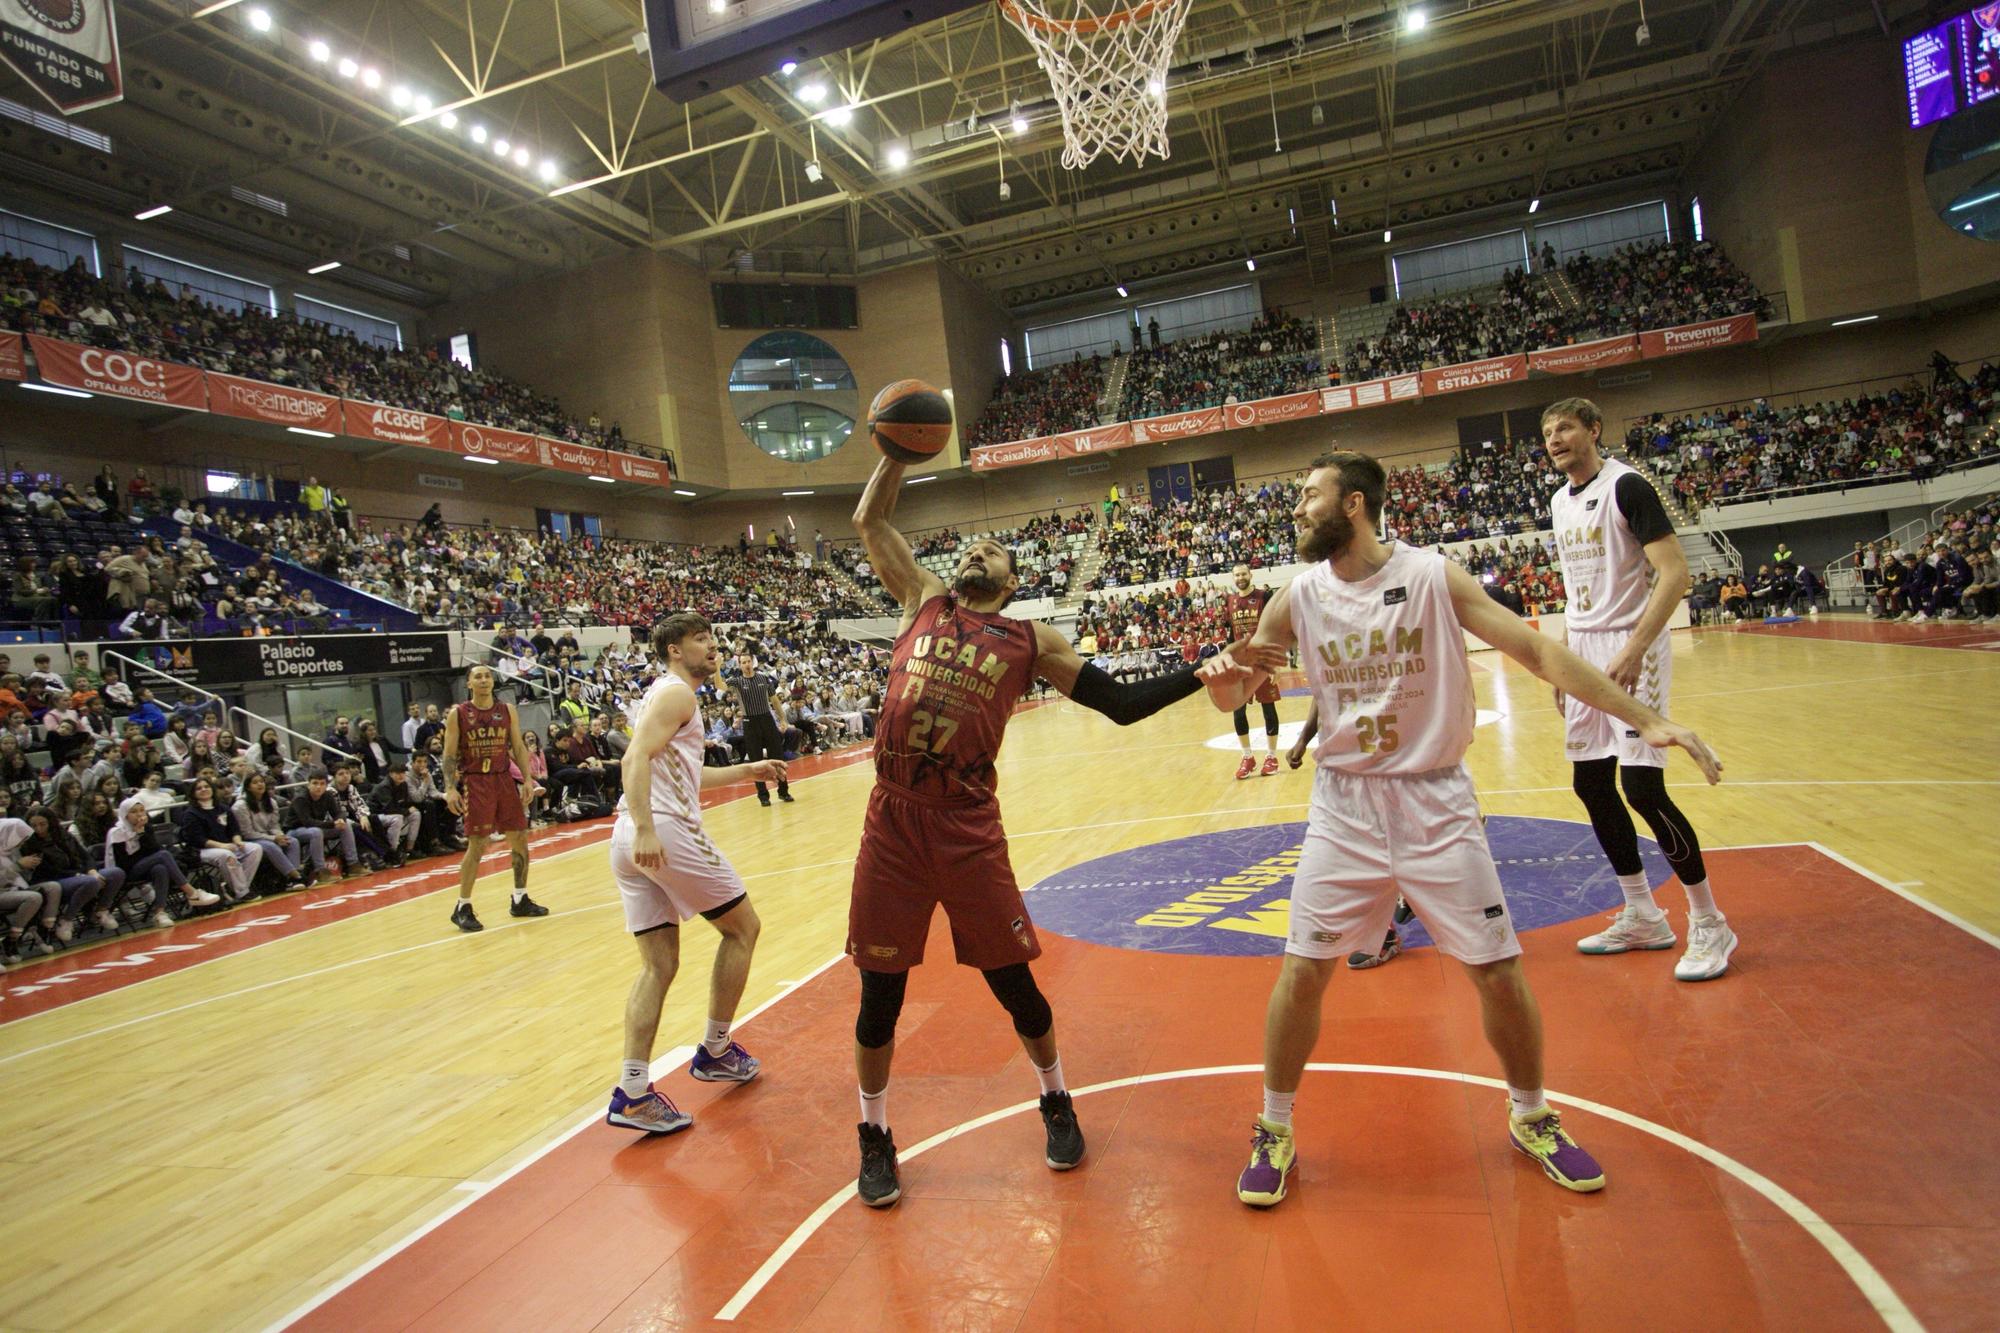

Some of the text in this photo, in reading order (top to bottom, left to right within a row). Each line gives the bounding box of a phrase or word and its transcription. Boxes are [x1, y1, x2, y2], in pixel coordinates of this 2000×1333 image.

[2, 31, 104, 82] FUNDADO EN
[35, 61, 82, 89] 1985
[1664, 323, 1731, 345] Prevemur
[1711, 335, 1732, 345] Salud
[1472, 362, 1504, 373] dentales
[1258, 406, 1281, 418] Costa
[1281, 401, 1308, 415] Cálida
[993, 444, 1050, 463] CaixaBank
[1576, 585, 1592, 612] 13
[1232, 609, 1258, 620] UCAM
[260, 643, 315, 660] Palacio
[1317, 626, 1424, 667] UCAM
[263, 661, 273, 669] de
[277, 658, 344, 677] Deportes
[913, 635, 1009, 686] UCAM
[1324, 658, 1426, 684] UNIVERSIDAD
[264, 668, 275, 678] los
[906, 658, 997, 702] UNIVERSIDAD
[1361, 684, 1404, 695] CARAVCA
[467, 727, 507, 741] UCAM
[907, 710, 959, 754] 27
[1356, 714, 1399, 753] 25
[482, 758, 491, 773] 0
[1135, 844, 1304, 928] ERSIDAD
[197, 914, 293, 940] de
[0, 943, 204, 1002] Mur
